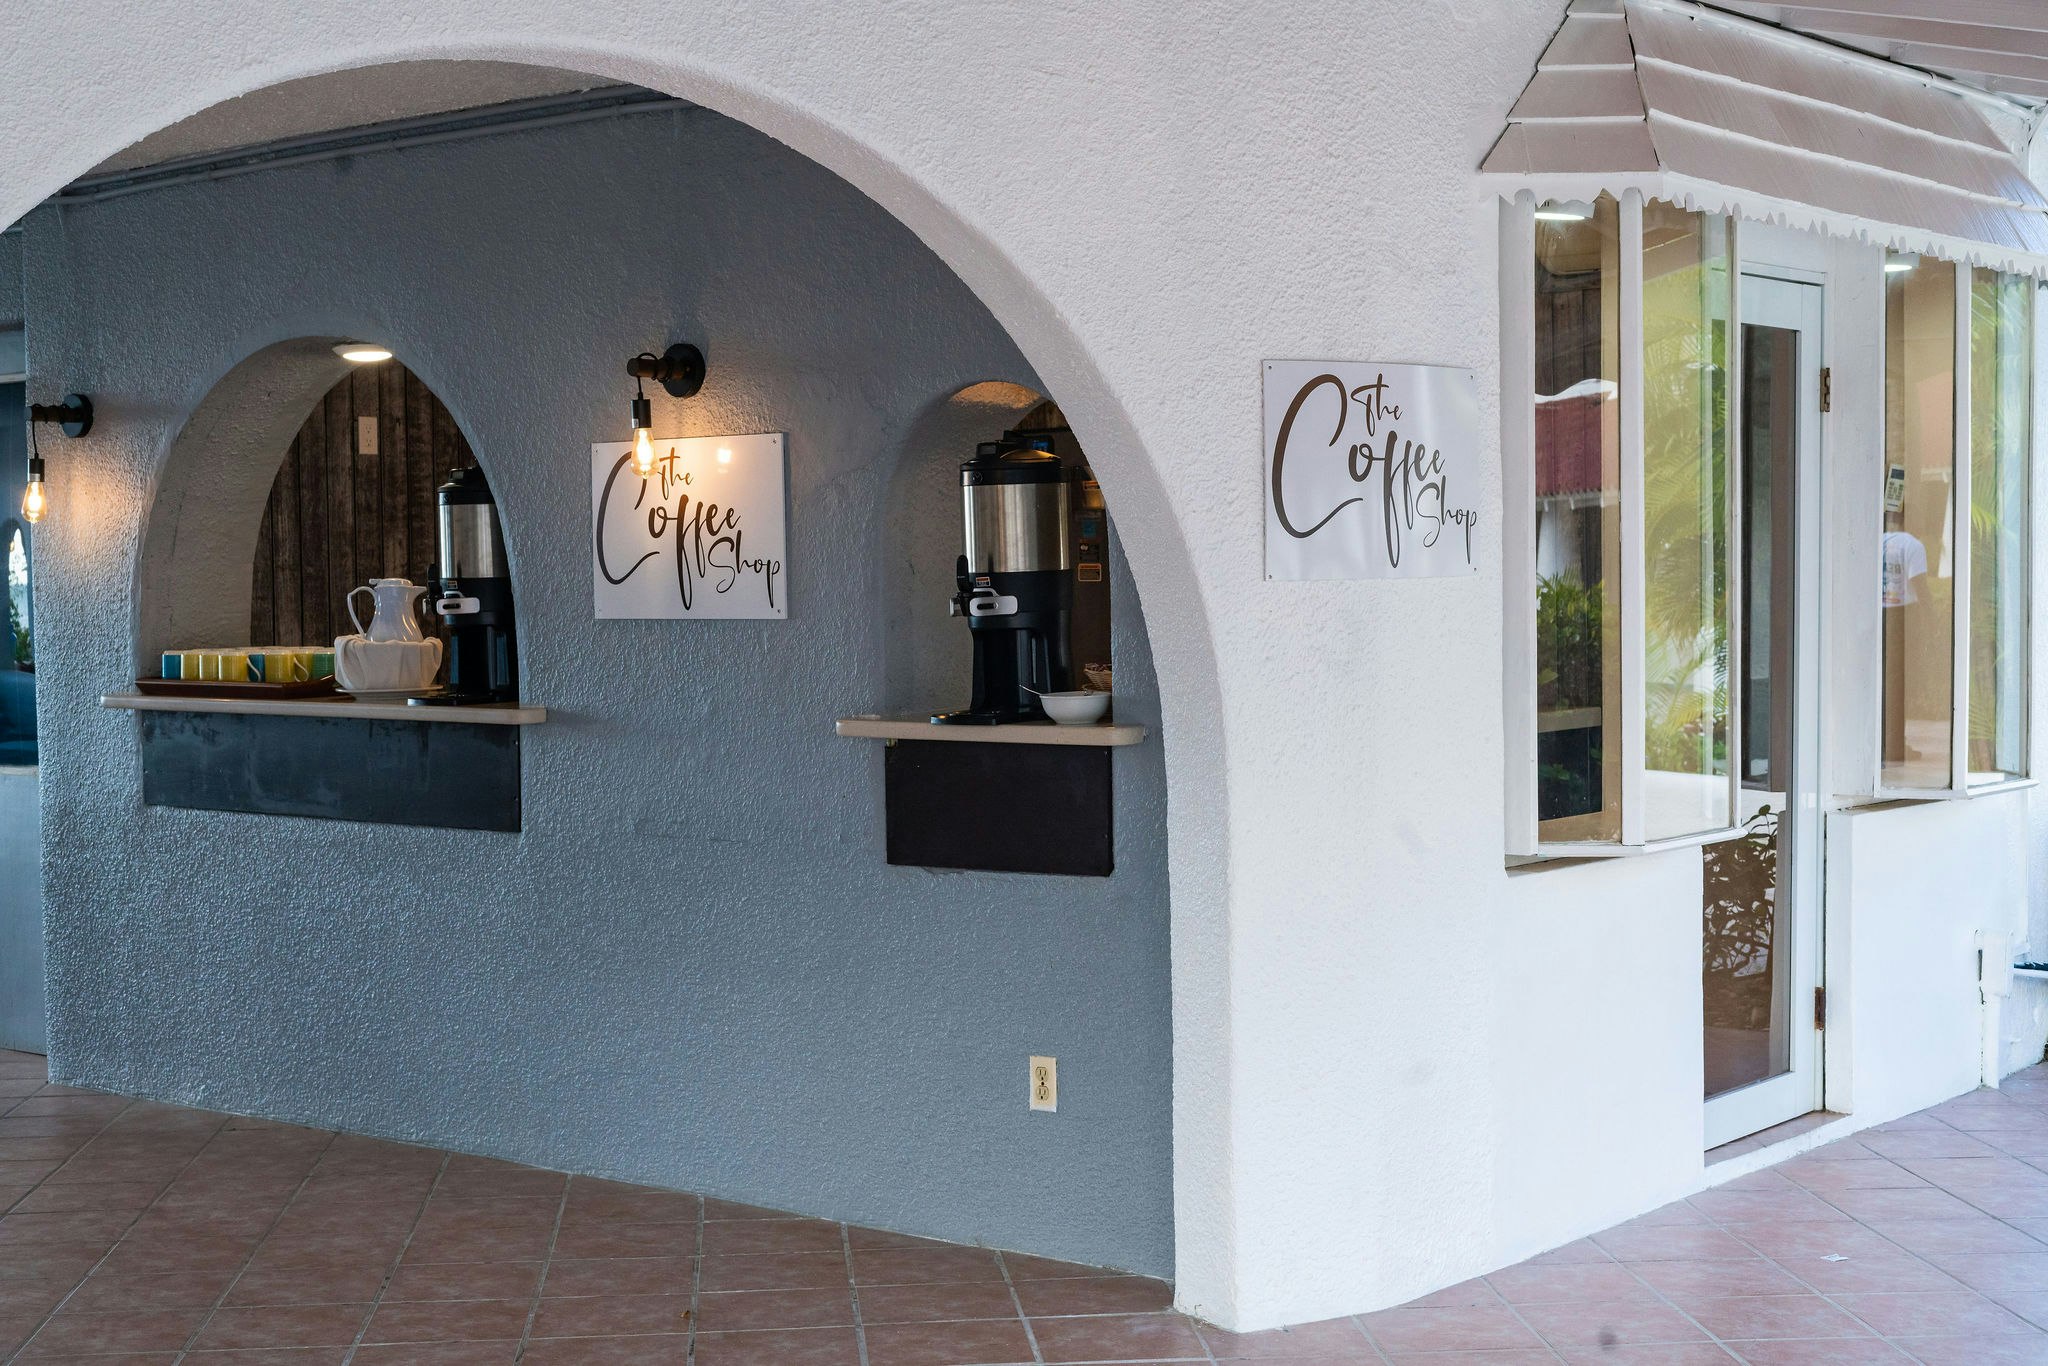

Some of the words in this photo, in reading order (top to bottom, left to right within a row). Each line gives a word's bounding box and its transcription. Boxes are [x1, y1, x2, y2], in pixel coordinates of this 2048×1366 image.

[596, 450, 742, 611] Coffee
[1271, 373, 1446, 569] Coffee
[1415, 475, 1478, 565] Shop
[707, 529, 781, 609] Shop
